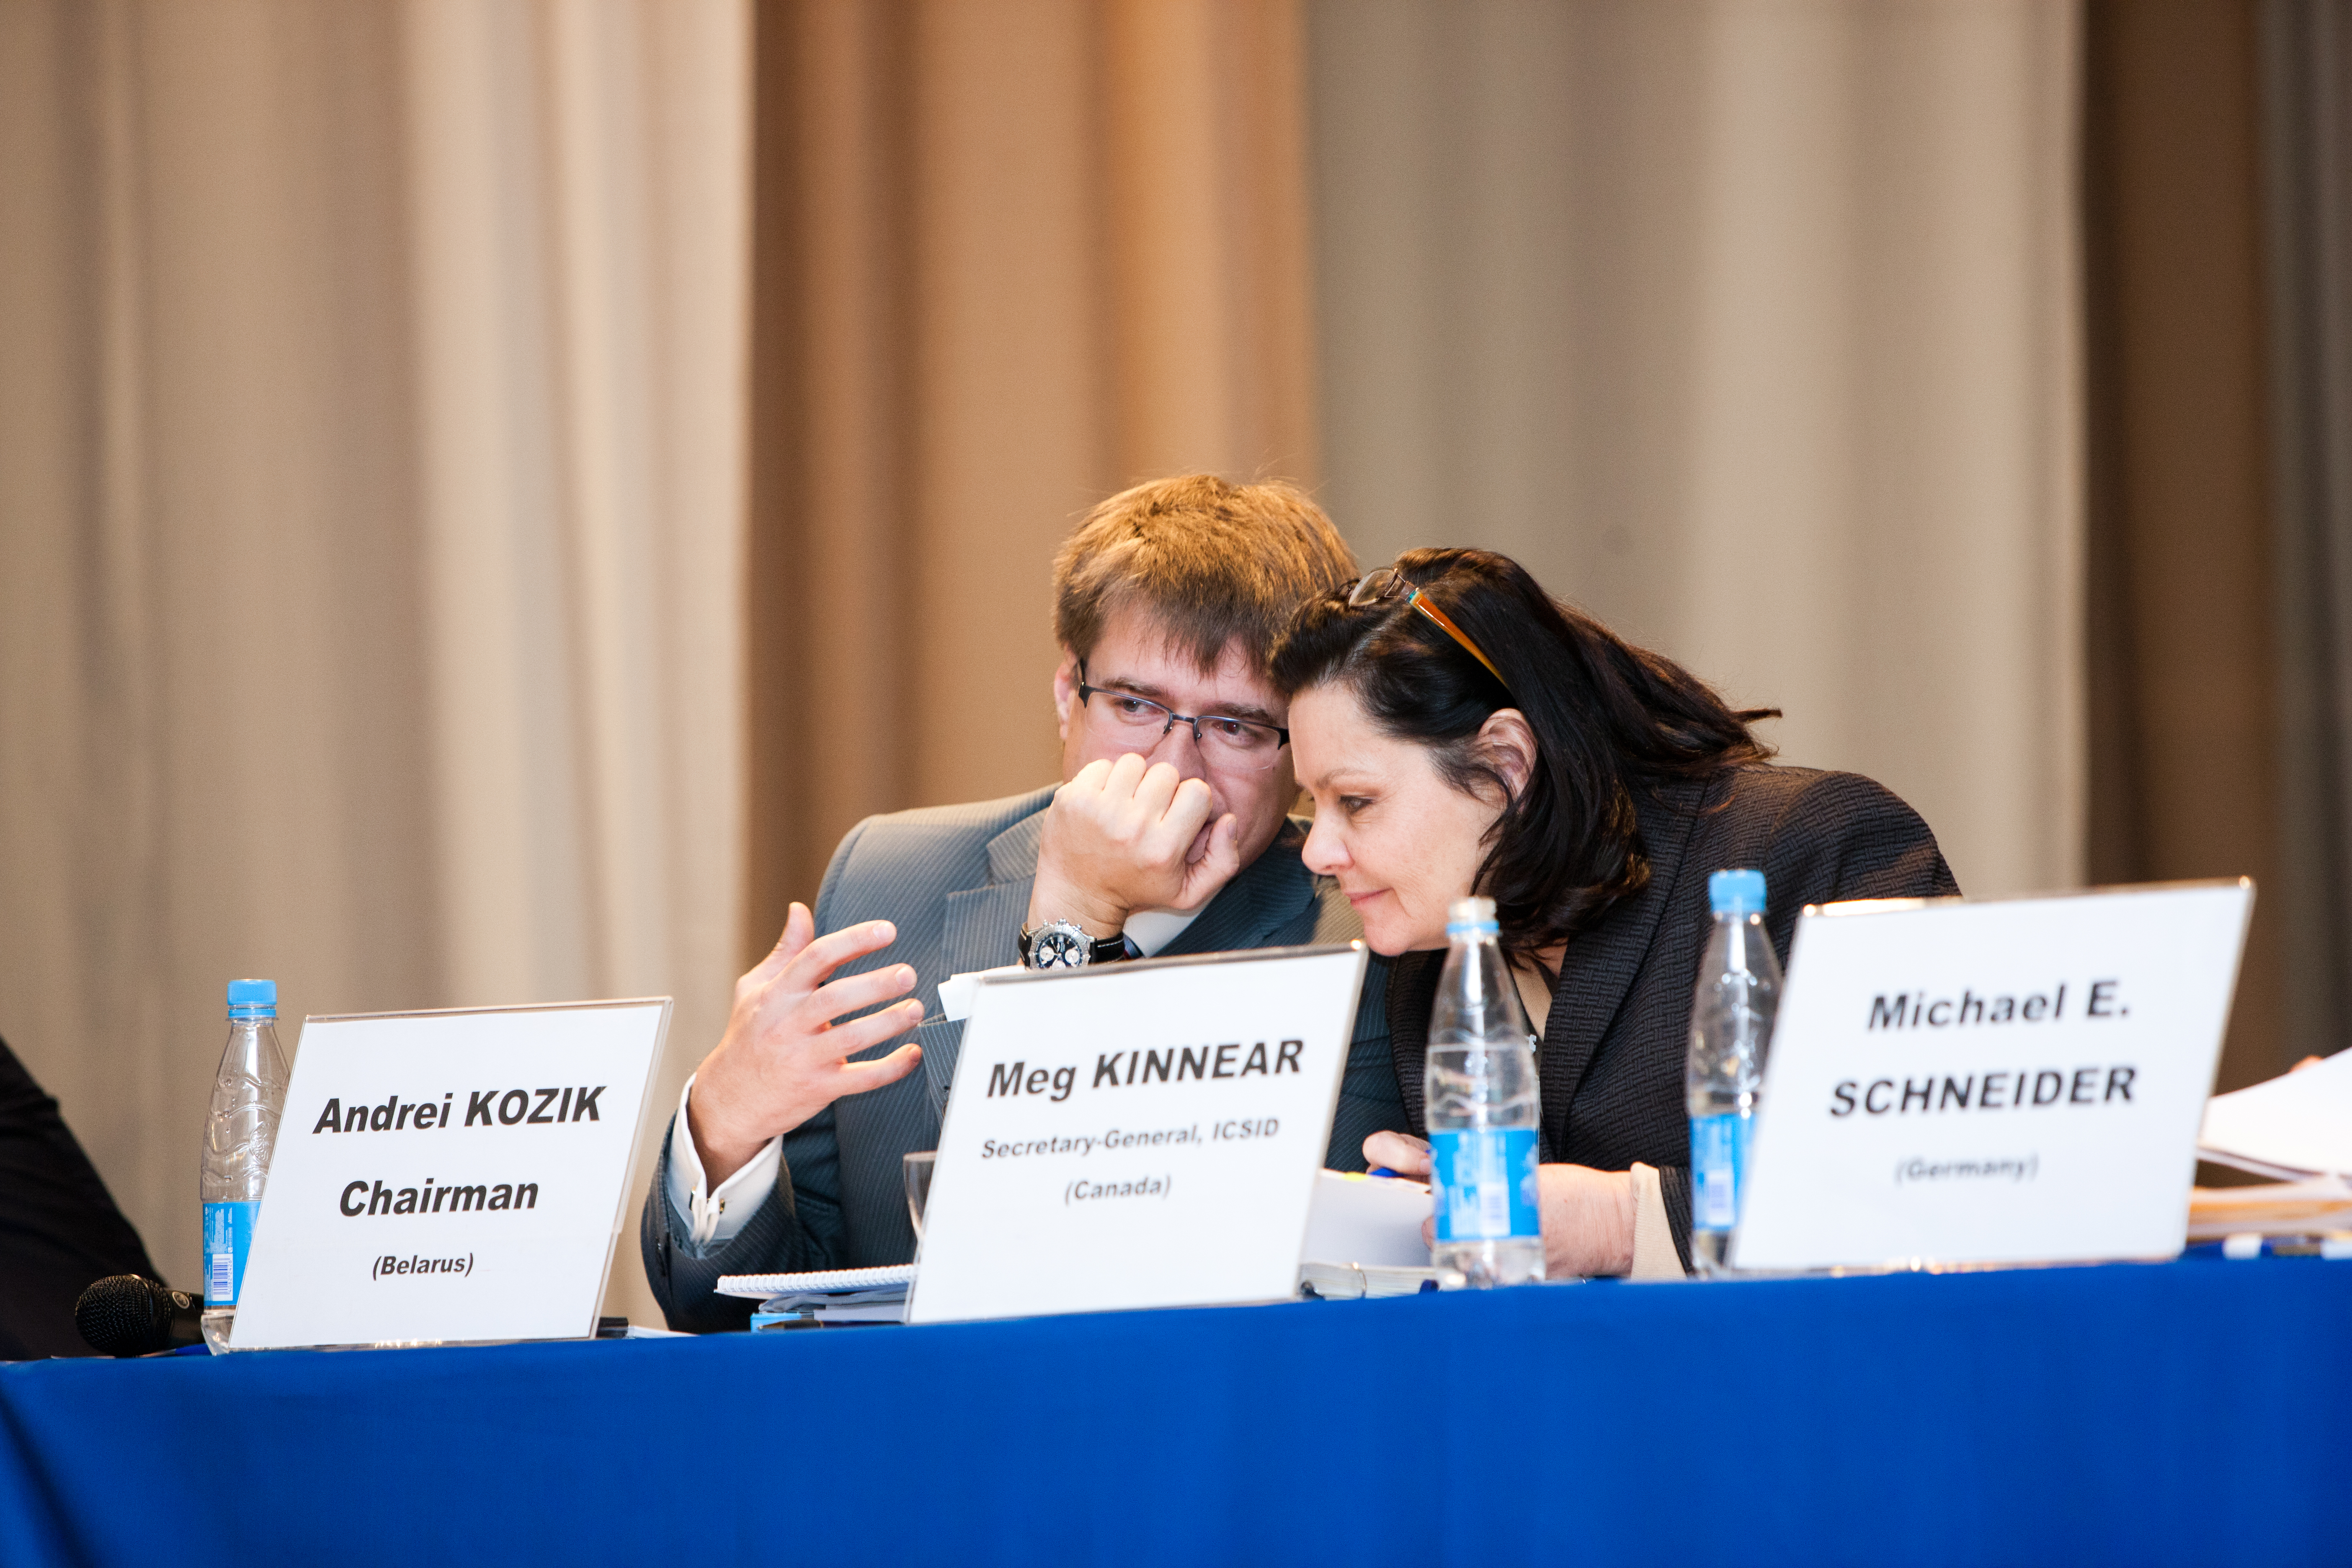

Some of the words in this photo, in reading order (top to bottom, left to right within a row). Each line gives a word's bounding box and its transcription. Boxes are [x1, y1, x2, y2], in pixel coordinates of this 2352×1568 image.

[1868, 983, 2067, 1030] Michael
[2086, 980, 2130, 1018] E.
[987, 1061, 1077, 1103] Meg
[1092, 1039, 1304, 1089] KINNEAR
[1830, 1066, 2138, 1117] SCHNEIDER
[312, 1093, 453, 1134] Andrei
[464, 1086, 606, 1127] KOZIK
[981, 1124, 1203, 1159] Secretary-General,
[1212, 1117, 1280, 1140] ICSID
[1065, 1175, 1171, 1205] (Canada)
[1896, 1155, 2039, 1184] (Germany)
[340, 1178, 538, 1217] Chairman
[372, 1252, 474, 1282] (Belarus)
